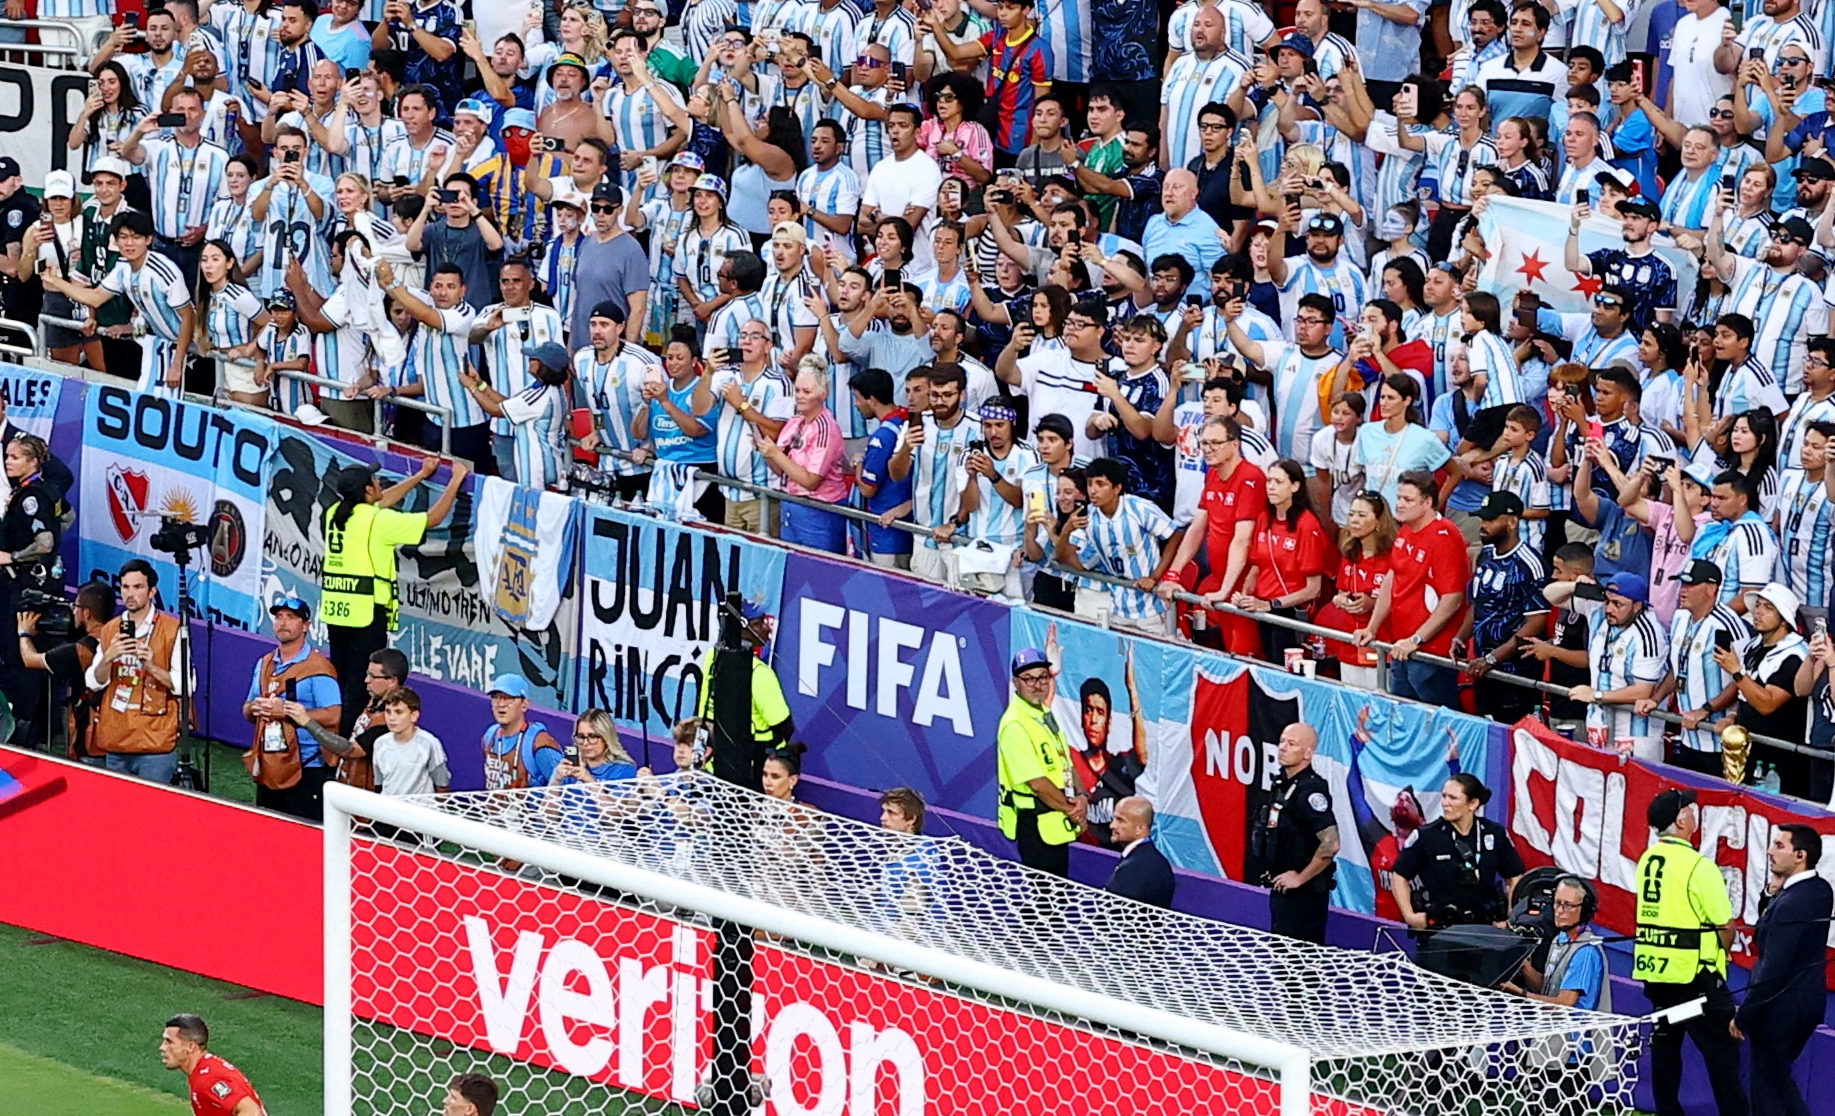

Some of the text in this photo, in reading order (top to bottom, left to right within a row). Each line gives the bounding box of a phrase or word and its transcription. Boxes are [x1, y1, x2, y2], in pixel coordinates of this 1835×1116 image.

[96, 386, 270, 488] SOUTO
[590, 517, 741, 642] JUAN
[798, 597, 975, 738] FIFA
